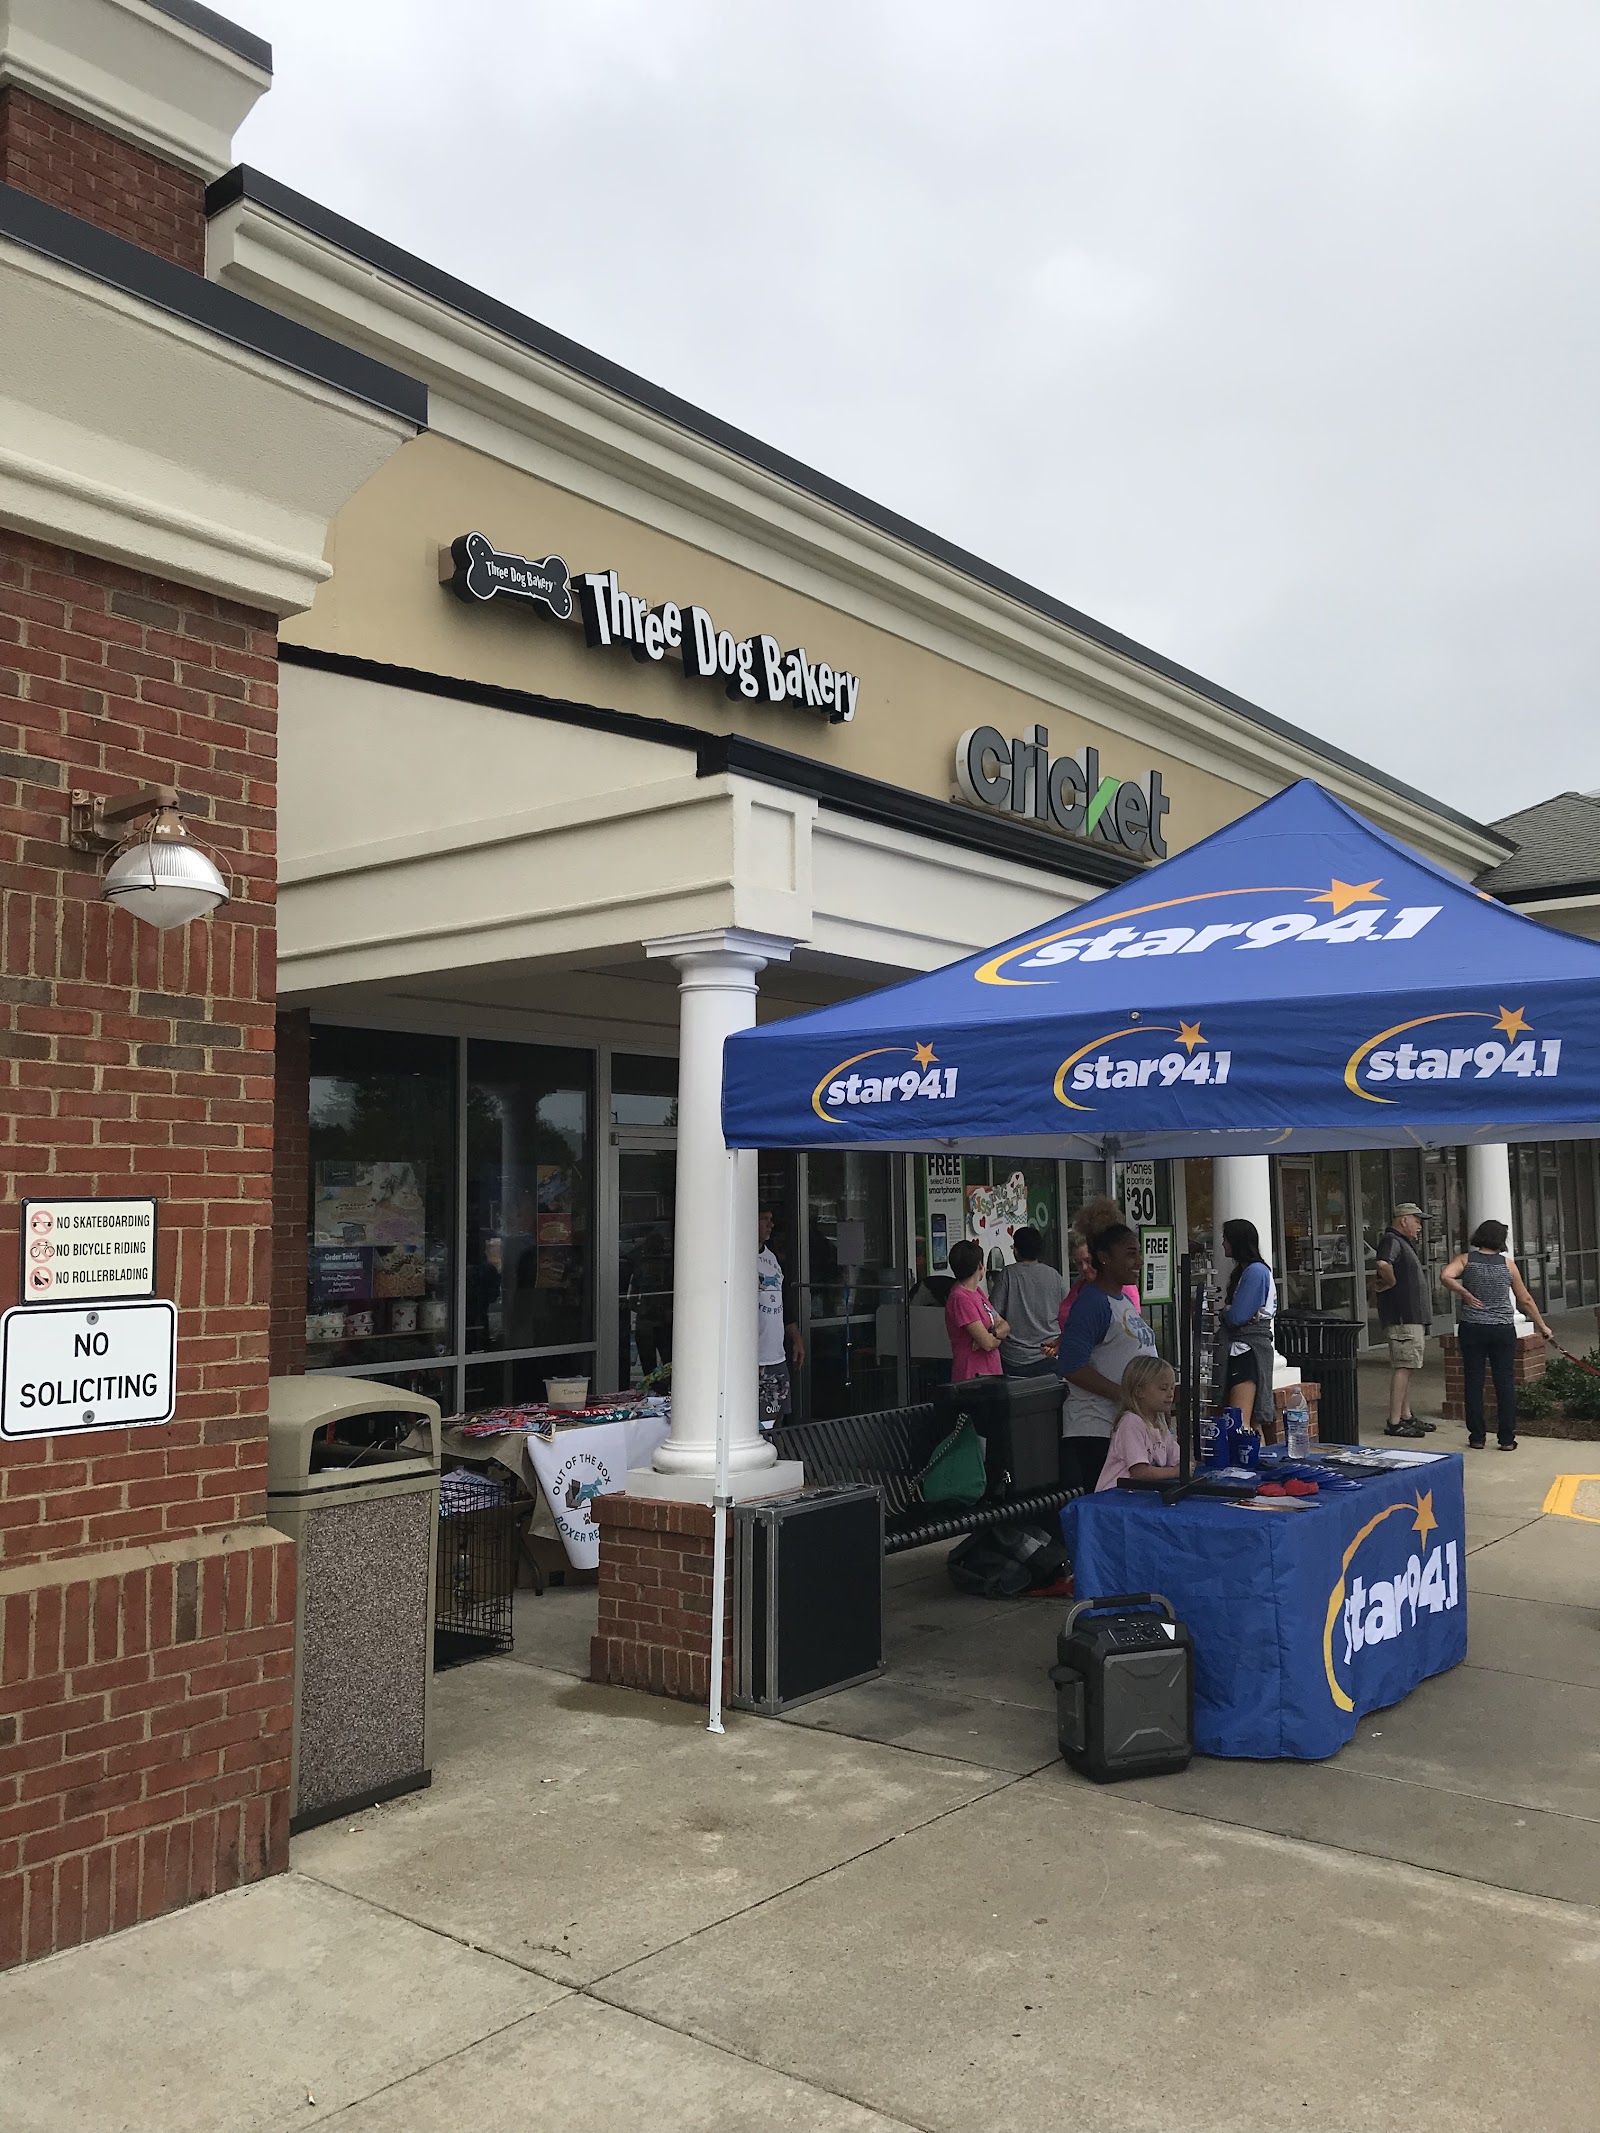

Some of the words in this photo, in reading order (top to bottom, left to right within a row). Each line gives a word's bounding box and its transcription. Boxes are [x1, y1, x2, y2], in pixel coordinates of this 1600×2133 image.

[486, 561, 508, 579] Three
[510, 567, 527, 587] Dog
[527, 572, 553, 592] Bakery
[585, 570, 682, 660] Three
[692, 606, 760, 697] Dog
[761, 634, 860, 721] Bakery
[960, 724, 1170, 859] cricket
[1018, 906, 1444, 968] star94.1
[1070, 1051, 1231, 1090] star94.1
[1365, 1039, 1562, 1081] star94.1
[826, 1068, 958, 1106] star94.1
[928, 1154, 960, 1176] FREE
[1126, 1162, 1152, 1175] Planes
[1127, 1187, 1154, 1221] $30
[56, 1216, 70, 1229] NO
[73, 1215, 150, 1228] SKATEBOARDING
[56, 1244, 70, 1256] NO
[73, 1243, 111, 1256] BICYCLE
[114, 1241, 146, 1254] RIDING
[1145, 1237, 1168, 1254] FREE
[56, 1271, 69, 1284] NO
[72, 1268, 148, 1283] ROLLERBLADING
[74, 1332, 109, 1357] NO
[20, 1373, 158, 1408] SOLICITING
[553, 1469, 566, 1495] OUT
[565, 1456, 577, 1470] OF
[579, 1454, 597, 1466] THE
[597, 1461, 612, 1485] BOX
[556, 1516, 586, 1542] BOXER
